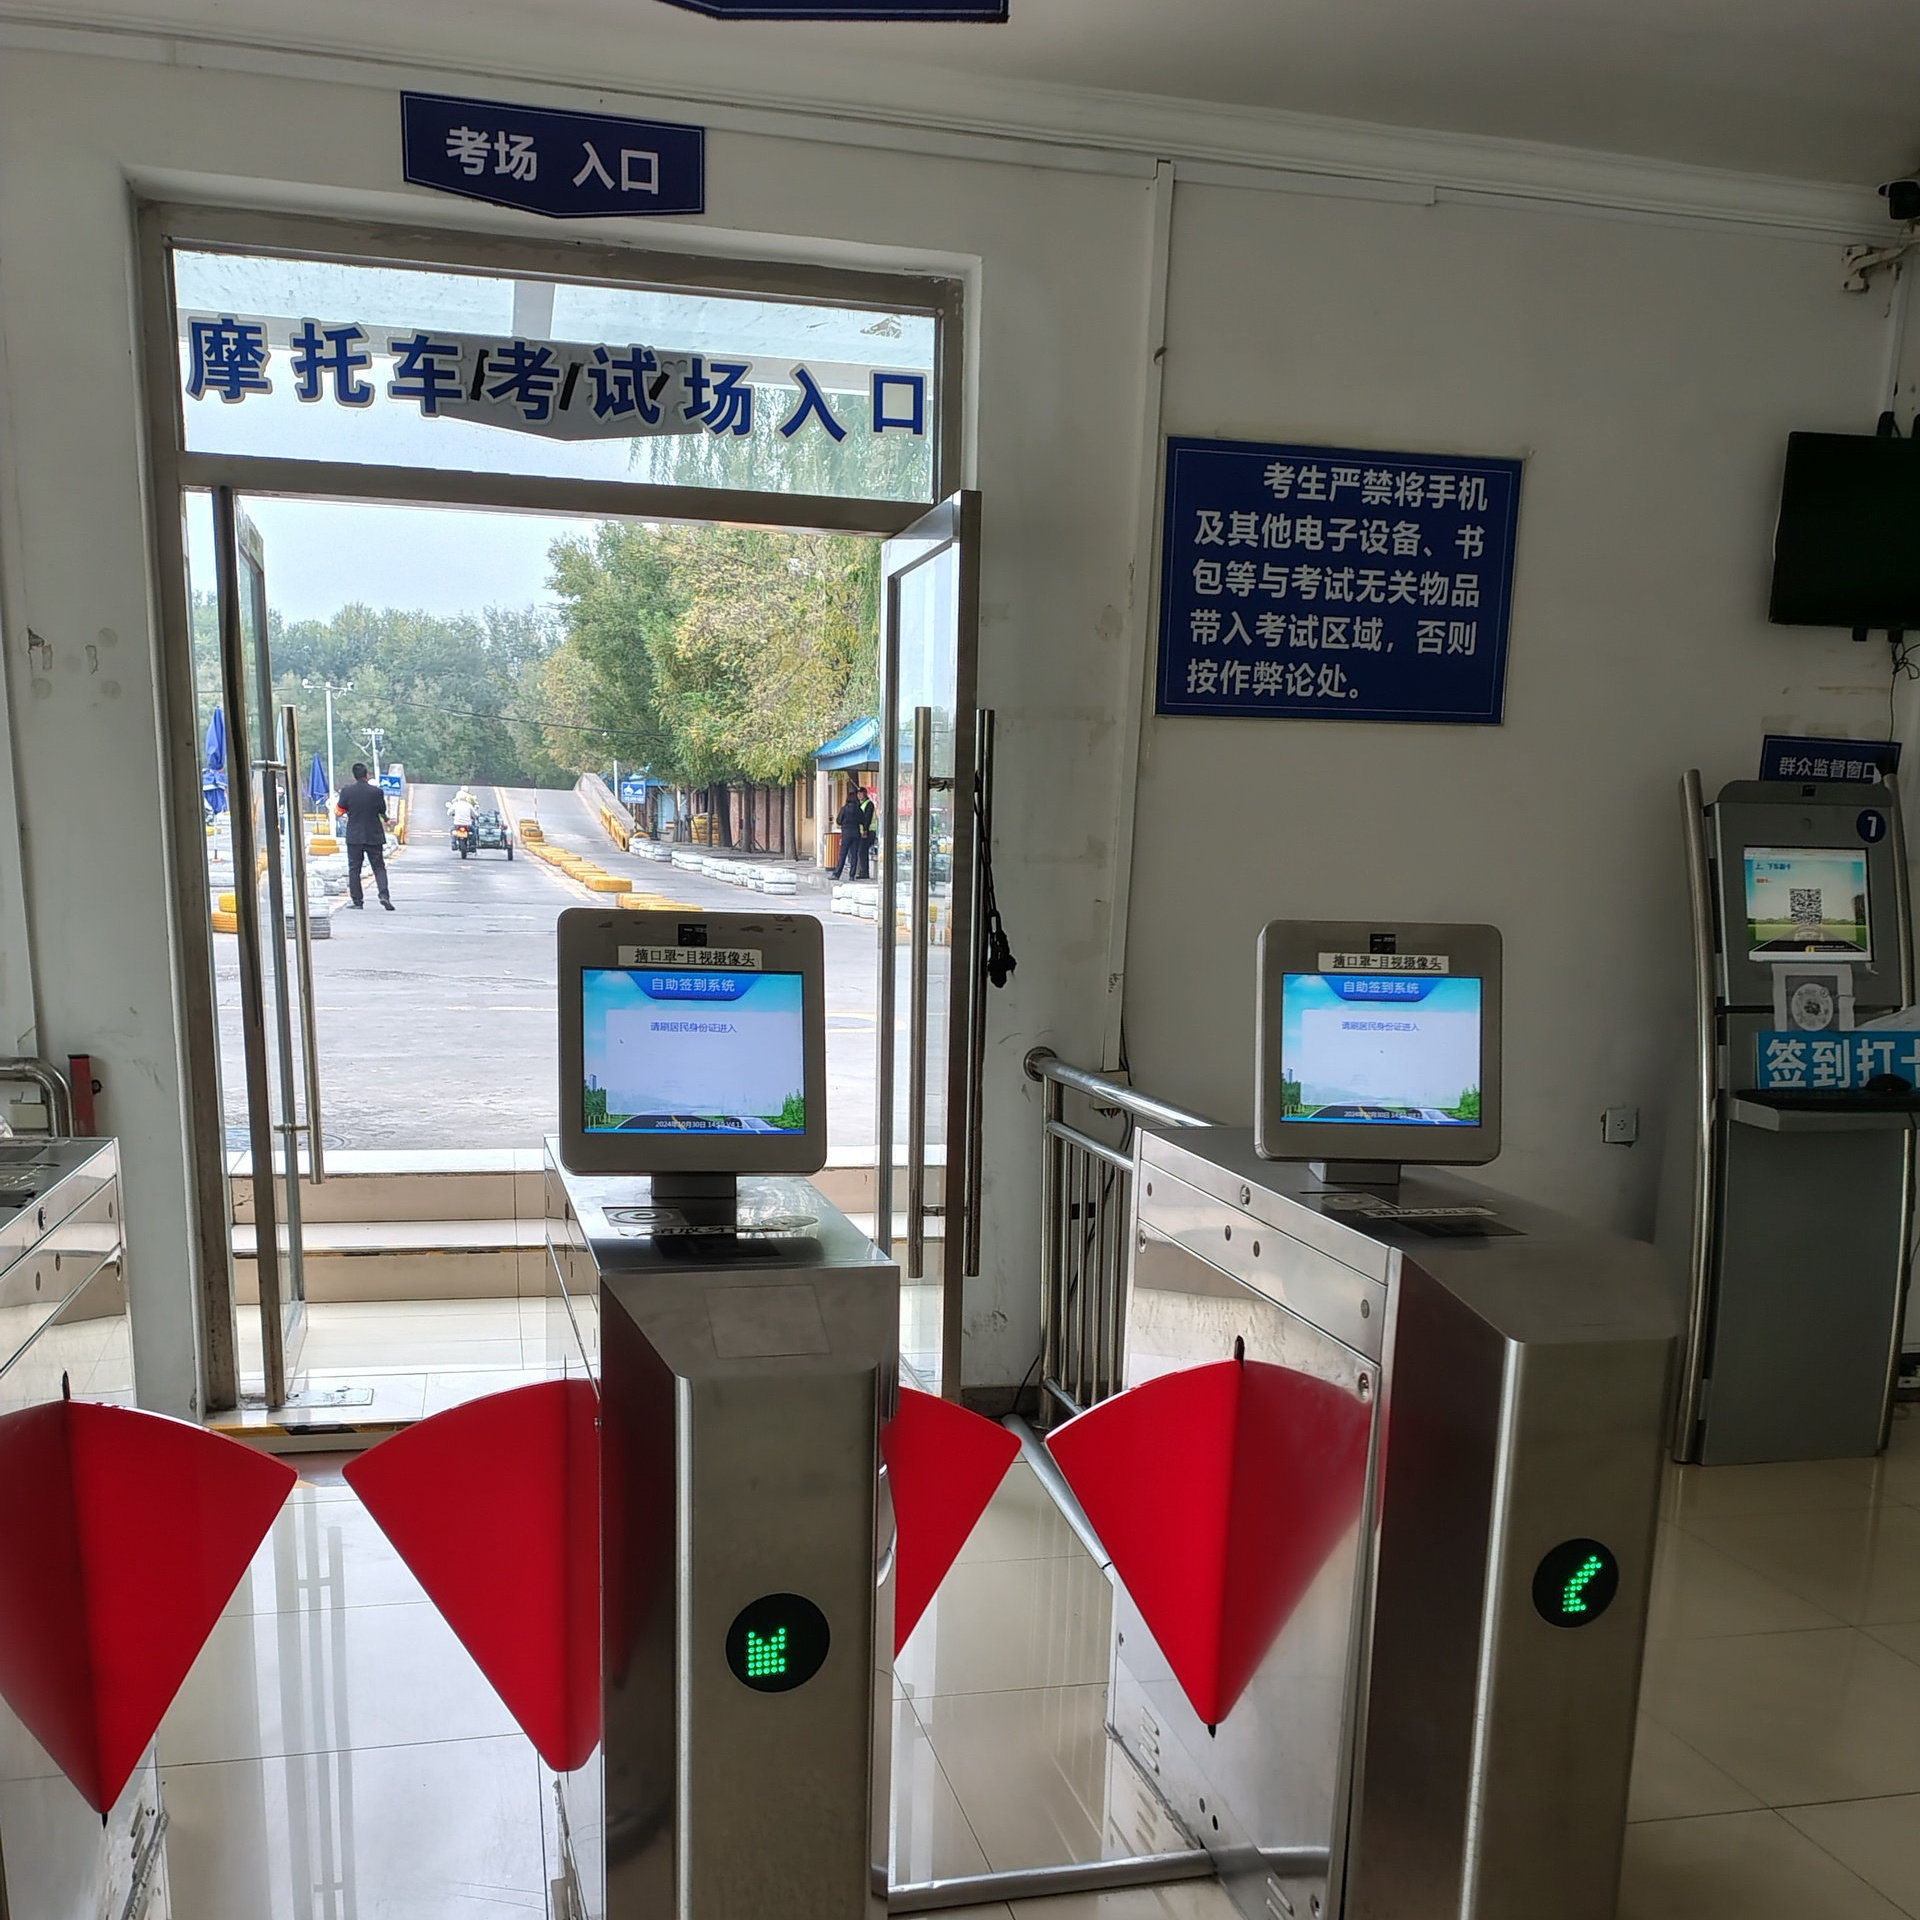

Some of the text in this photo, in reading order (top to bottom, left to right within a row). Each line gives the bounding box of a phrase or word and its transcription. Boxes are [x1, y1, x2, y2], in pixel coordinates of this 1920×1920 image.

[446, 126, 660, 195] 考场 入口
[1263, 461, 1488, 512] 考生严禁将手机
[1194, 510, 1486, 560] 及其他电子设备、书
[1192, 558, 1480, 608] 包等与考试无关物品
[1189, 608, 1478, 656] 带入考试区域，否则
[1186, 658, 1360, 699] 按作弊论处。
[1778, 756, 1878, 780] 群众监督窗口
[651, 977, 736, 993] 自助签到系统
[1343, 981, 1420, 995] 自助签到系统
[650, 1021, 737, 1034] 请刷居民身份证进入
